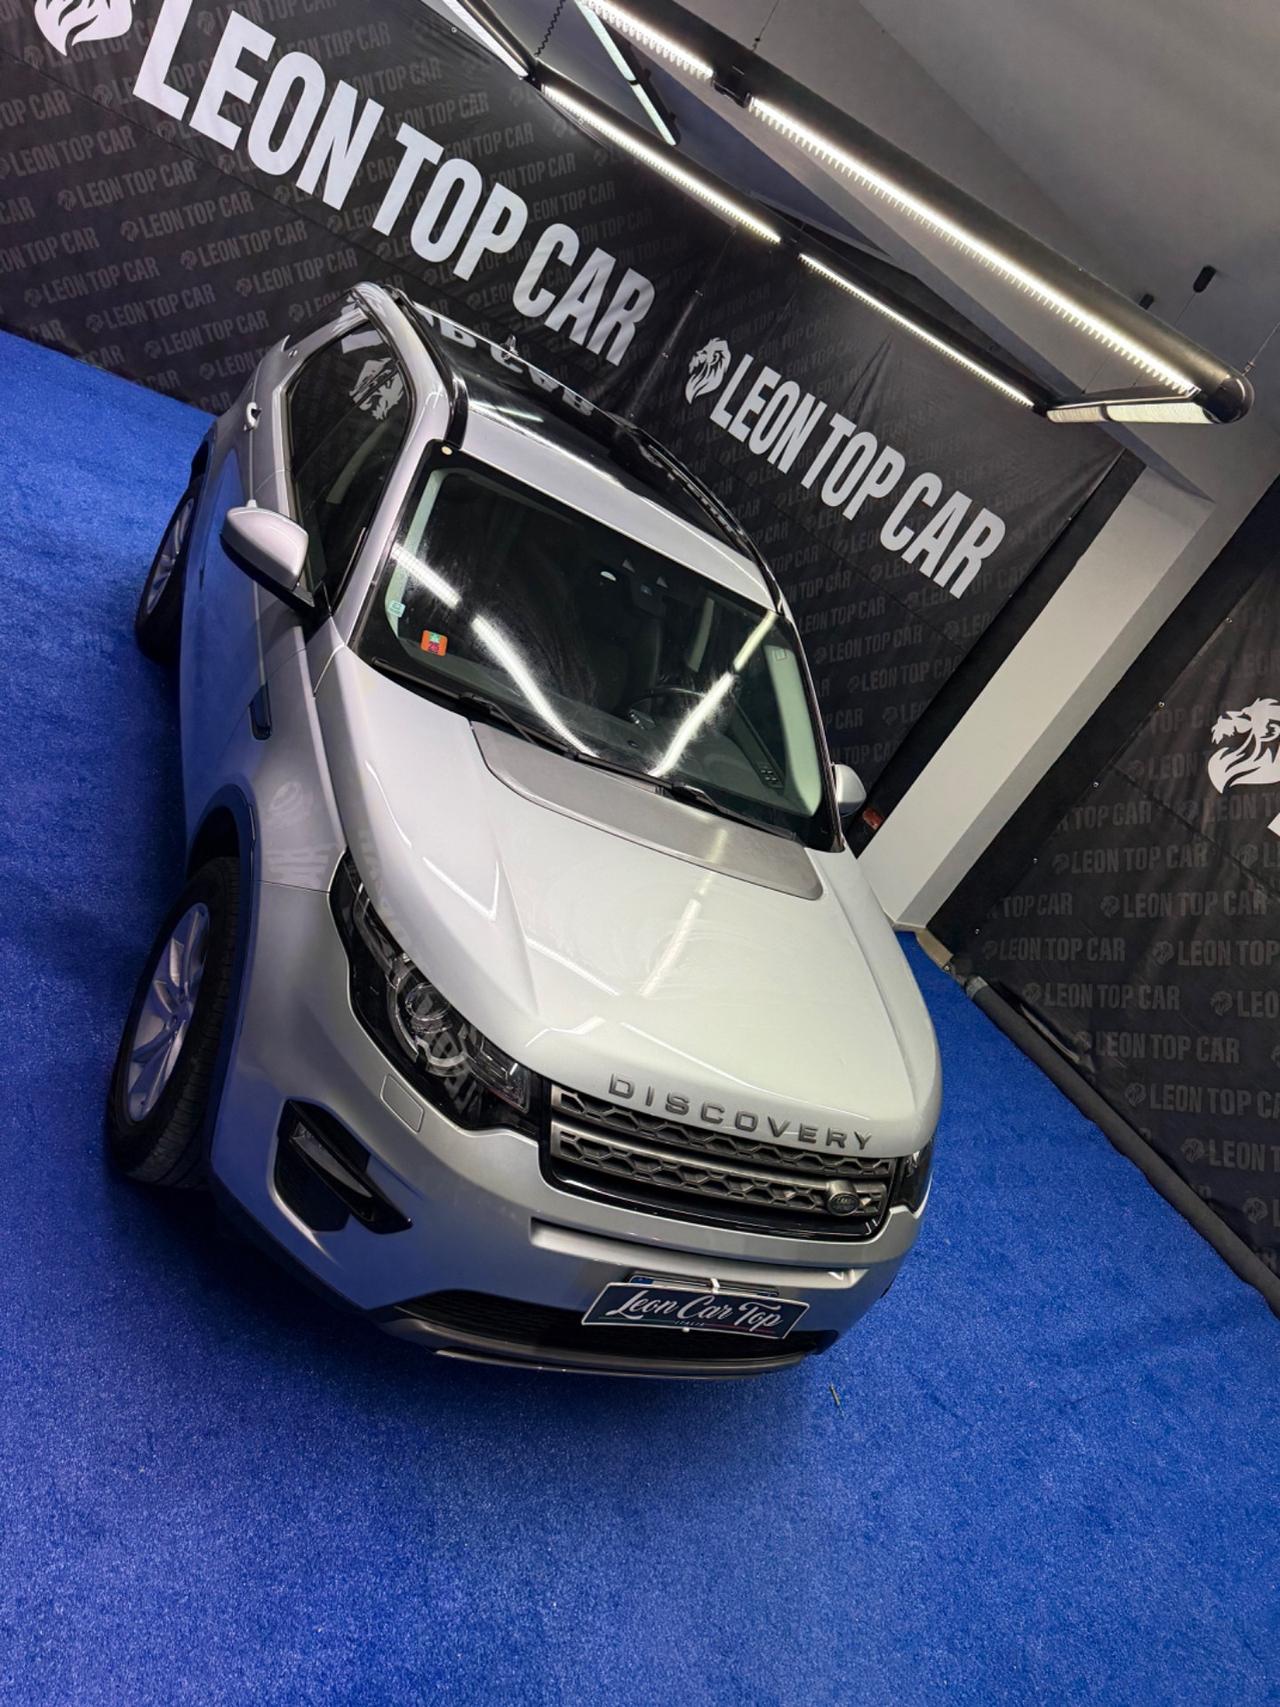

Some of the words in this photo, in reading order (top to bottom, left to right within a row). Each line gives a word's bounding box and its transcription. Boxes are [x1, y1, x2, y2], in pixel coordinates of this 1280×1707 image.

[356, 21, 392, 51] CAR
[29, 89, 72, 121] CAR
[8, 144, 61, 177] LEON
[58, 134, 96, 165] TOP
[96, 125, 137, 155] CAR
[505, 121, 535, 148] CAR
[548, 152, 577, 179] CAR
[75, 174, 125, 209] LEON
[122, 167, 158, 197] TOP
[159, 158, 198, 189] CAR
[132, 0, 385, 212] LEON
[371, 122, 529, 282] TOP
[512, 222, 656, 367] CAR
[138, 208, 185, 239] LEON
[183, 202, 216, 228] TOP
[218, 190, 254, 219] CAR
[22, 237, 58, 265] TOP
[60, 226, 100, 255] CAR
[197, 238, 241, 268] LEON
[240, 229, 272, 255] TOP
[274, 219, 308, 246] CAR
[42, 272, 89, 304] LEON
[86, 264, 120, 291] TOP
[122, 256, 160, 283] CAR
[252, 268, 292, 294] LEON
[292, 259, 324, 282] TOP
[326, 247, 359, 273] CAR
[102, 302, 148, 330] LEON
[146, 293, 179, 319] TOP
[181, 283, 217, 310] CAR
[161, 327, 203, 355] LEON
[202, 319, 234, 343] TOP
[236, 309, 269, 334] CAR
[709, 352, 828, 475] LEON
[801, 411, 906, 521] TOP
[880, 472, 1007, 599] CAR
[858, 596, 886, 620] CAR
[829, 638, 863, 663] LEON
[864, 630, 892, 655] TOP
[861, 668, 898, 692] LEON
[900, 660, 931, 685] TOP
[835, 707, 864, 731] CAR
[1073, 805, 1110, 831] TOP
[1112, 800, 1151, 827] CAR
[1072, 847, 1120, 874] LEON
[1122, 846, 1161, 872] TOP
[1167, 841, 1209, 869] CAR
[1002, 894, 1034, 918] TOP
[1037, 892, 1073, 916] CAR
[1123, 892, 1173, 919] LEON
[1175, 891, 1218, 917] TOP
[1223, 889, 1268, 916] CAR
[1000, 937, 1041, 961] LEON
[1044, 937, 1083, 961] TOP
[1086, 936, 1126, 962] CAR
[1177, 940, 1231, 967] LEON
[1236, 940, 1280, 967] TOP
[1043, 982, 1093, 1009] LEON
[1097, 984, 1134, 1010] TOP
[1138, 984, 1180, 1011] CAR
[1237, 990, 1280, 1019] LEO
[1095, 1031, 1146, 1060] LEON
[1150, 1033, 1192, 1061] TOP
[1196, 1036, 1240, 1064] CAR
[608, 1072, 872, 1150] DISCOVERY
[1151, 1083, 1202, 1113] LEON
[1207, 1088, 1251, 1117] TOP
[1208, 1138, 1265, 1172] LEON
[605, 1289, 678, 1320] Leon
[676, 1294, 734, 1321] Car
[734, 1301, 784, 1332] Top
